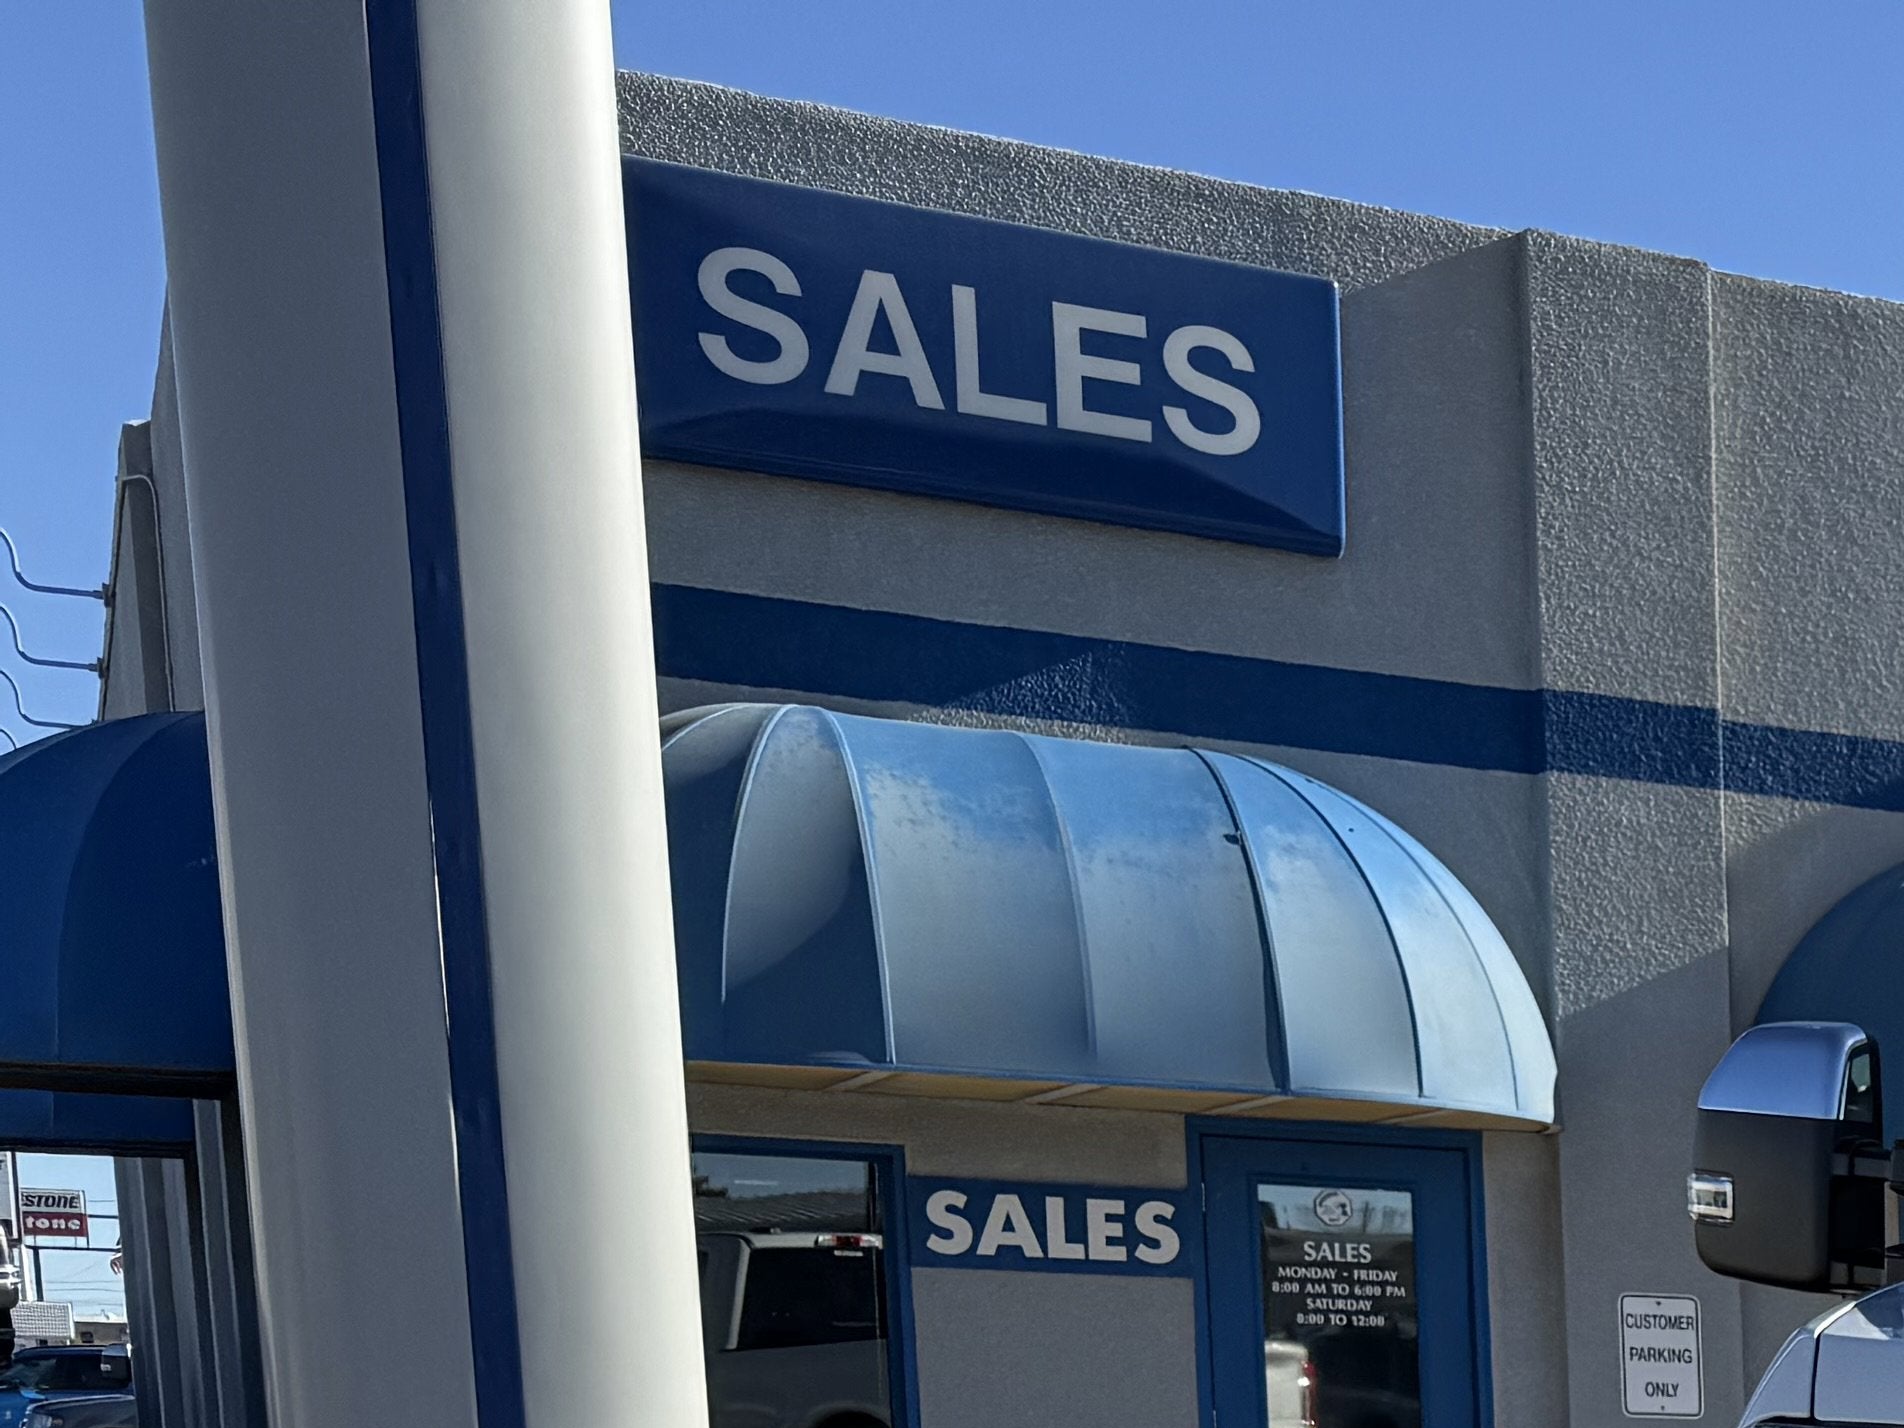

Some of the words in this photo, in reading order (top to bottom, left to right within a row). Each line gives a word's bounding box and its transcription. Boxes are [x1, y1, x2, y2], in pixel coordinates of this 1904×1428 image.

[697, 246, 1262, 456] SALES
[926, 1189, 1180, 1264] SALES
[1303, 1241, 1372, 1263] SALES
[1278, 1266, 1337, 1280] MONDAY
[1353, 1269, 1398, 1282] FRIDAY
[1272, 1281, 1299, 1293] 8:00
[1304, 1283, 1327, 1294] AM
[1331, 1283, 1349, 1296] TO
[1386, 1286, 1406, 1297] PM
[1306, 1298, 1373, 1311] SATURDAY
[1329, 1313, 1347, 1326] TO
[1352, 1315, 1385, 1327] 12:00
[1625, 1313, 1694, 1330] CUSTOMER
[1629, 1346, 1693, 1364] PARKING
[1644, 1381, 1679, 1397] ONLY
